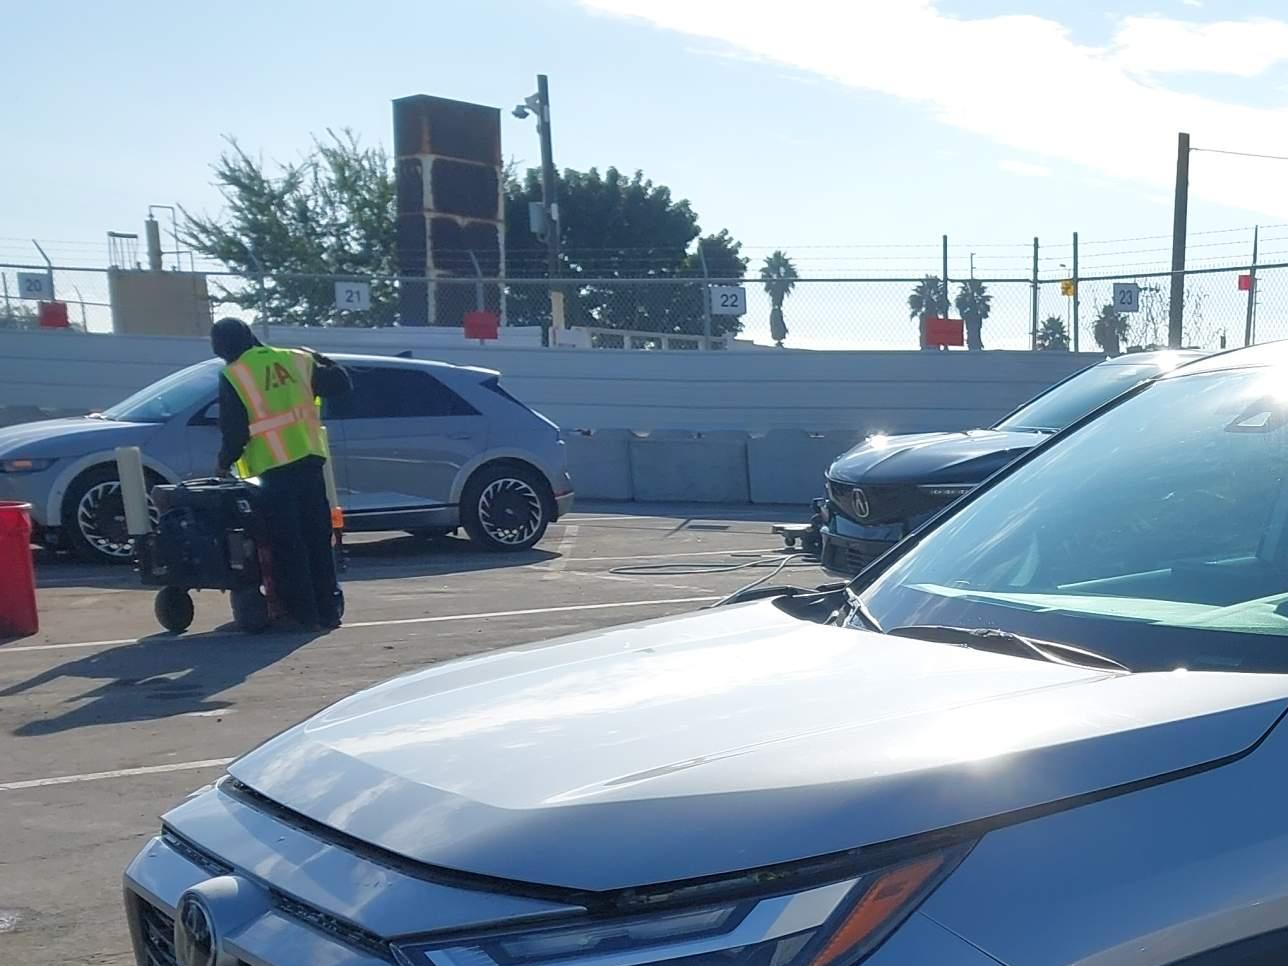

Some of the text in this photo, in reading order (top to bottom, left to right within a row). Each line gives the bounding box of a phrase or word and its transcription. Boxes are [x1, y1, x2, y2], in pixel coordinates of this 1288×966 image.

[26, 279, 42, 292] 20
[345, 289, 361, 303] 21
[721, 293, 738, 308] 22
[1119, 290, 1133, 305] 23
